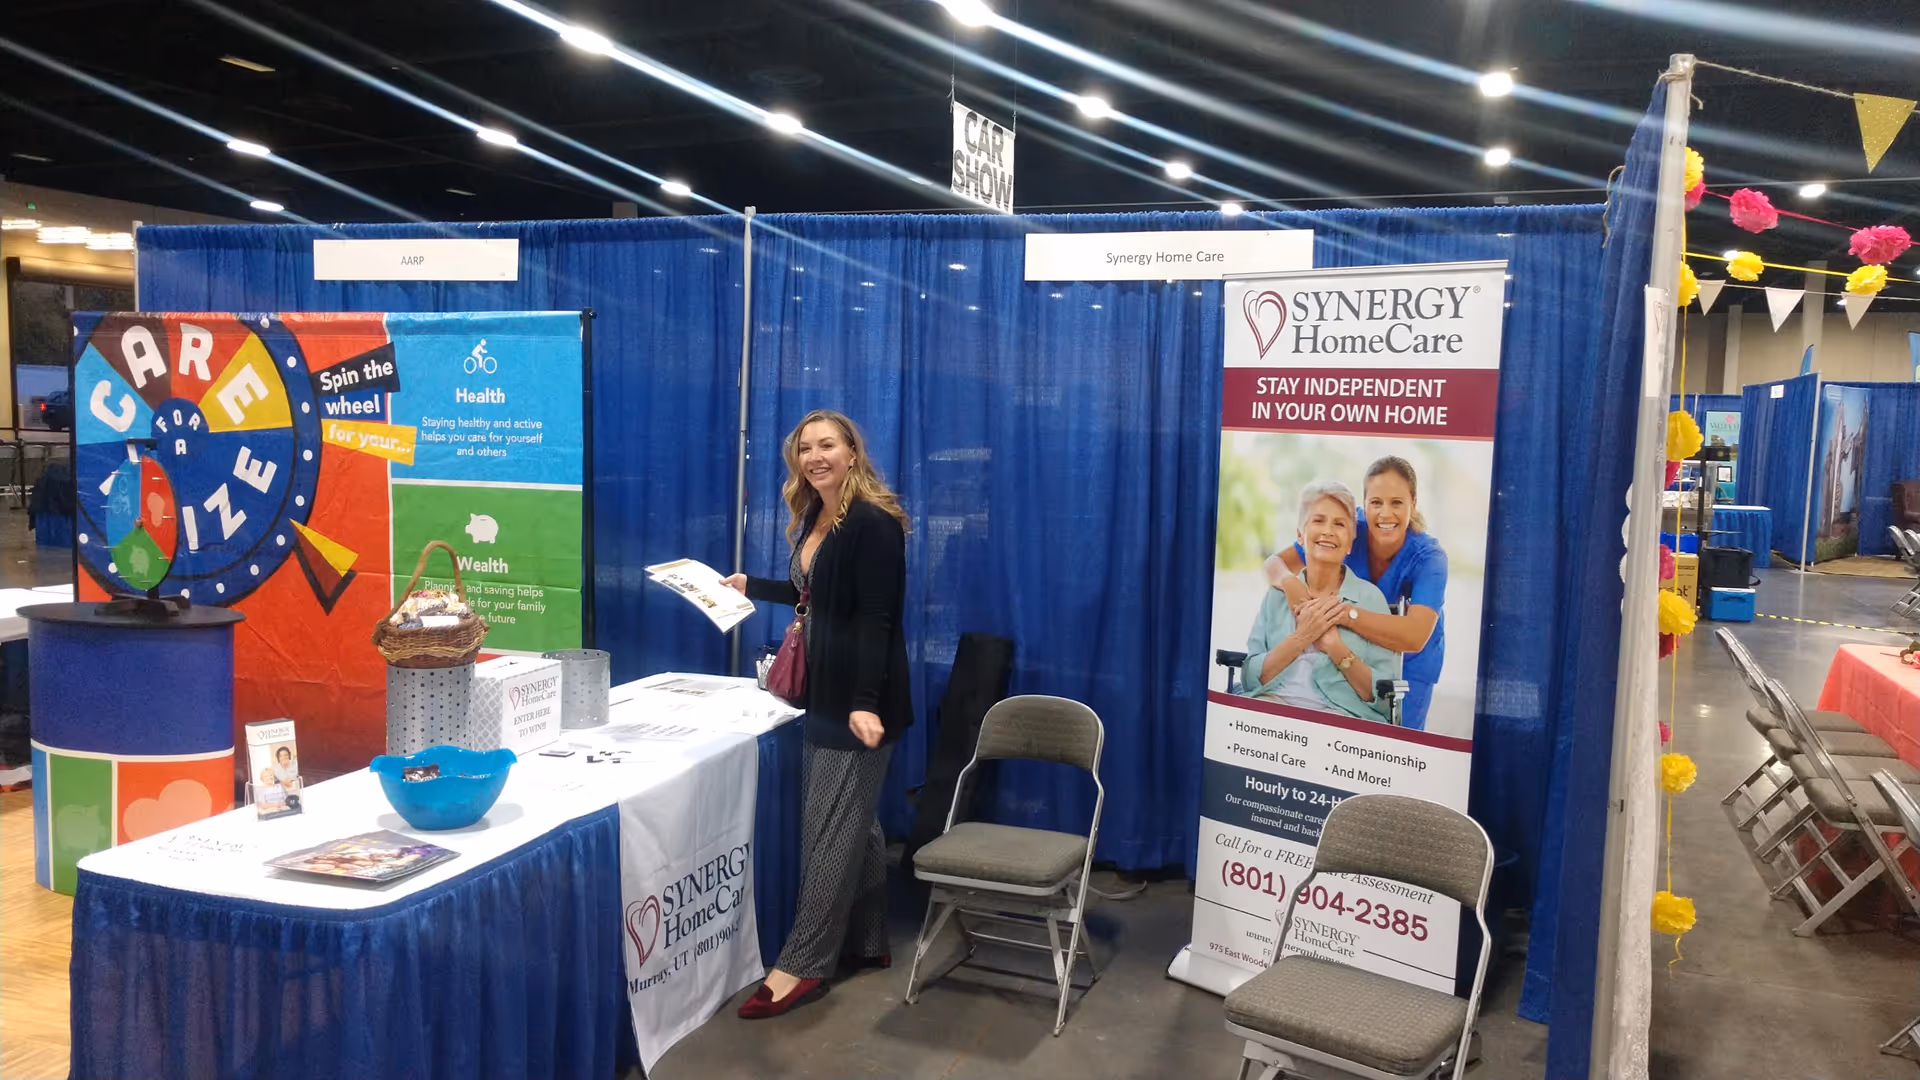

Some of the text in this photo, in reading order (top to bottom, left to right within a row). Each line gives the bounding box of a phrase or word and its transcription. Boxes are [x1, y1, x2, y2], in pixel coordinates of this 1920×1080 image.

[964, 111, 1004, 168] CAR
[953, 149, 1012, 212] SHOW
[401, 256, 425, 265] AARP
[1106, 250, 1224, 265] Synergy Home Care
[1291, 286, 1471, 322] SYNERGY
[1291, 322, 1463, 354] HomeCare
[90, 322, 269, 433] CARE
[320, 360, 393, 393] Spin the
[1256, 377, 1446, 398] STAY INDEPENDENT
[325, 394, 380, 415] wheel
[456, 387, 506, 404] Health
[156, 409, 201, 433] FOR
[422, 416, 543, 431] Staying healthy and active
[1252, 402, 1448, 425] IN YOUR OWN HOME
[175, 438, 187, 455] A
[329, 424, 411, 453] for your...
[421, 430, 543, 445] helps you care for yourself
[457, 445, 507, 458] and others
[456, 556, 509, 574] Wealth
[466, 583, 482, 594] and
[484, 584, 515, 598] saving
[517, 585, 544, 599] helps
[477, 597, 491, 608] for
[494, 601, 515, 611] your
[517, 599, 546, 615] family
[488, 612, 516, 624] future
[521, 678, 558, 696] SYNERGY
[521, 690, 557, 707] HomeCare
[514, 706, 552, 726] ENTER HERE
[518, 727, 530, 738] TO
[1235, 720, 1308, 746] Homemaking
[1233, 743, 1306, 768] Personal Care
[1334, 740, 1427, 772] Companionship
[1331, 764, 1391, 788] And More!
[1245, 775, 1341, 809] Hourly to 24-H
[1225, 793, 1241, 805] Our
[1242, 800, 1303, 820] compassionate
[1251, 812, 1321, 838] insured and back
[1215, 833, 1314, 870] Call for a FREE
[1222, 859, 1428, 942] (801) 904-2385
[1350, 873, 1435, 905] Assessment
[664, 885, 745, 950] HomeCar
[1294, 916, 1357, 946] SYNERGY
[1209, 942, 1224, 954] 975
[1224, 947, 1241, 960] East
[1294, 928, 1355, 959] HomeCare
[628, 967, 671, 995] Murray,
[674, 950, 689, 971] UT
